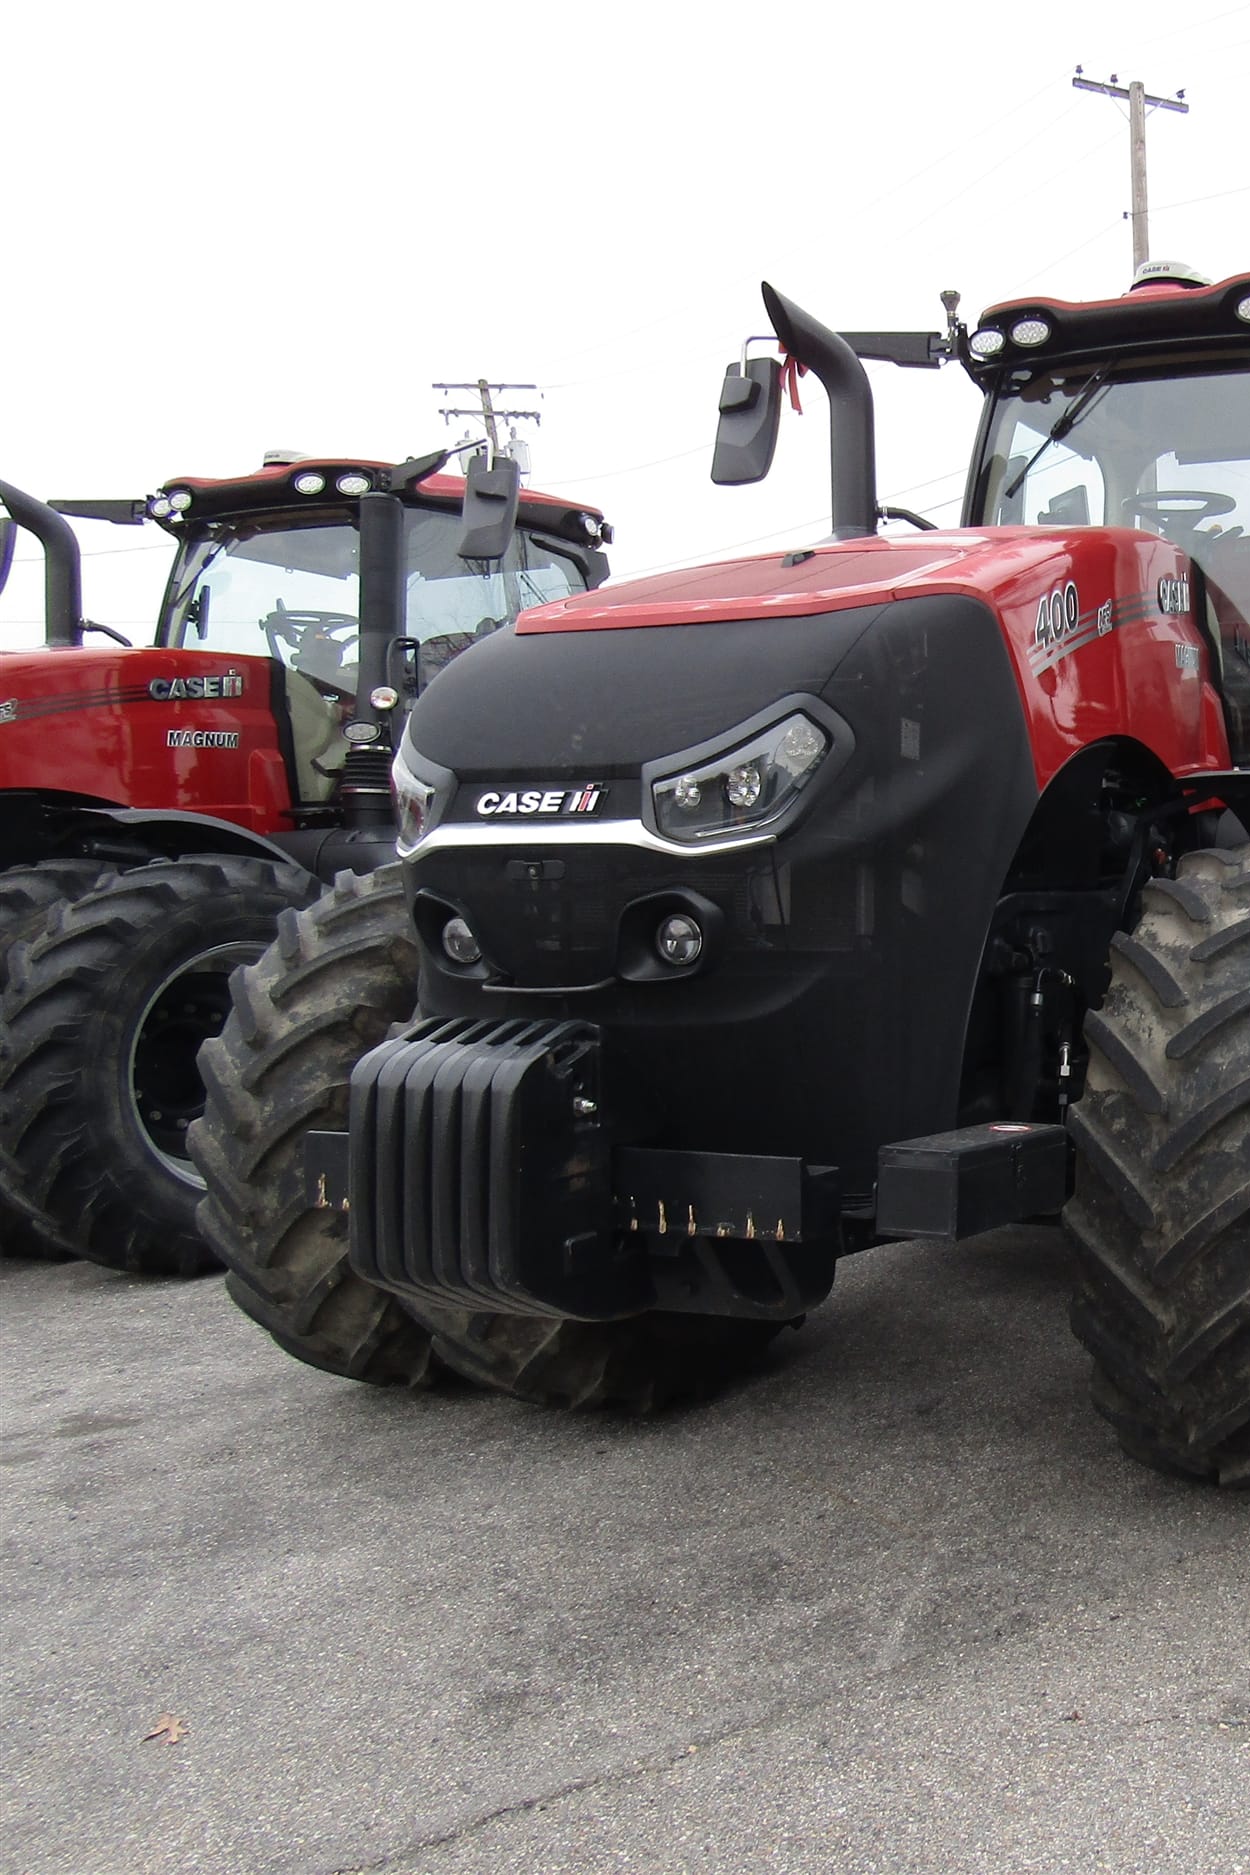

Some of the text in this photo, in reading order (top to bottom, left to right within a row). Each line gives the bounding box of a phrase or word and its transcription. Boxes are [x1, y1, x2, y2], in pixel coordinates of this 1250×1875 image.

[1034, 580, 1079, 648] 400
[149, 677, 220, 700] CASE
[166, 730, 239, 749] MAGNUM
[476, 791, 564, 814] CASE
